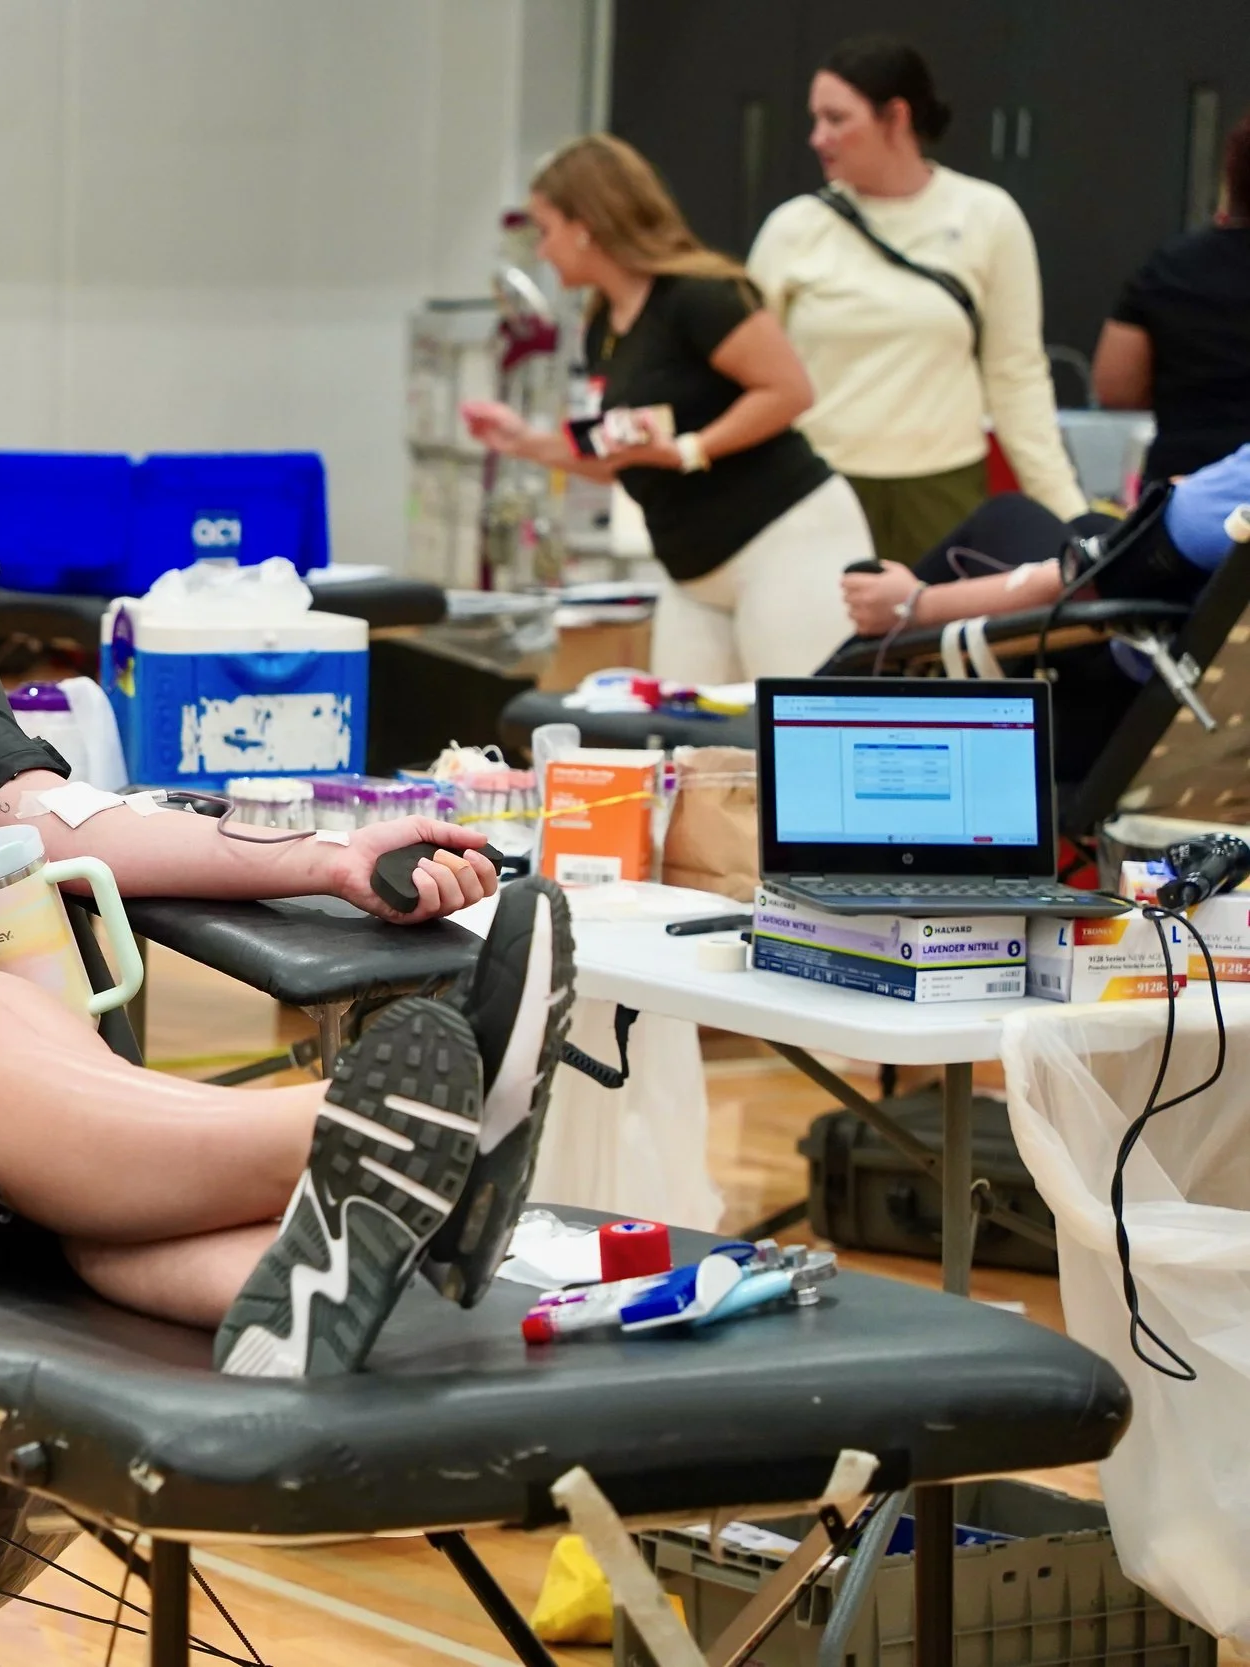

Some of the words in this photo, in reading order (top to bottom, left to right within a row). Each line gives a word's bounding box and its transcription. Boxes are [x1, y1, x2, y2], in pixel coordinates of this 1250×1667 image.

[934, 925, 972, 934] HALYARD
[1172, 925, 1182, 943] L
[1058, 927, 1067, 946] L
[922, 943, 965, 954] LAVENDER
[967, 941, 999, 952] NITRILE
[1137, 980, 1180, 993] 9128-0
